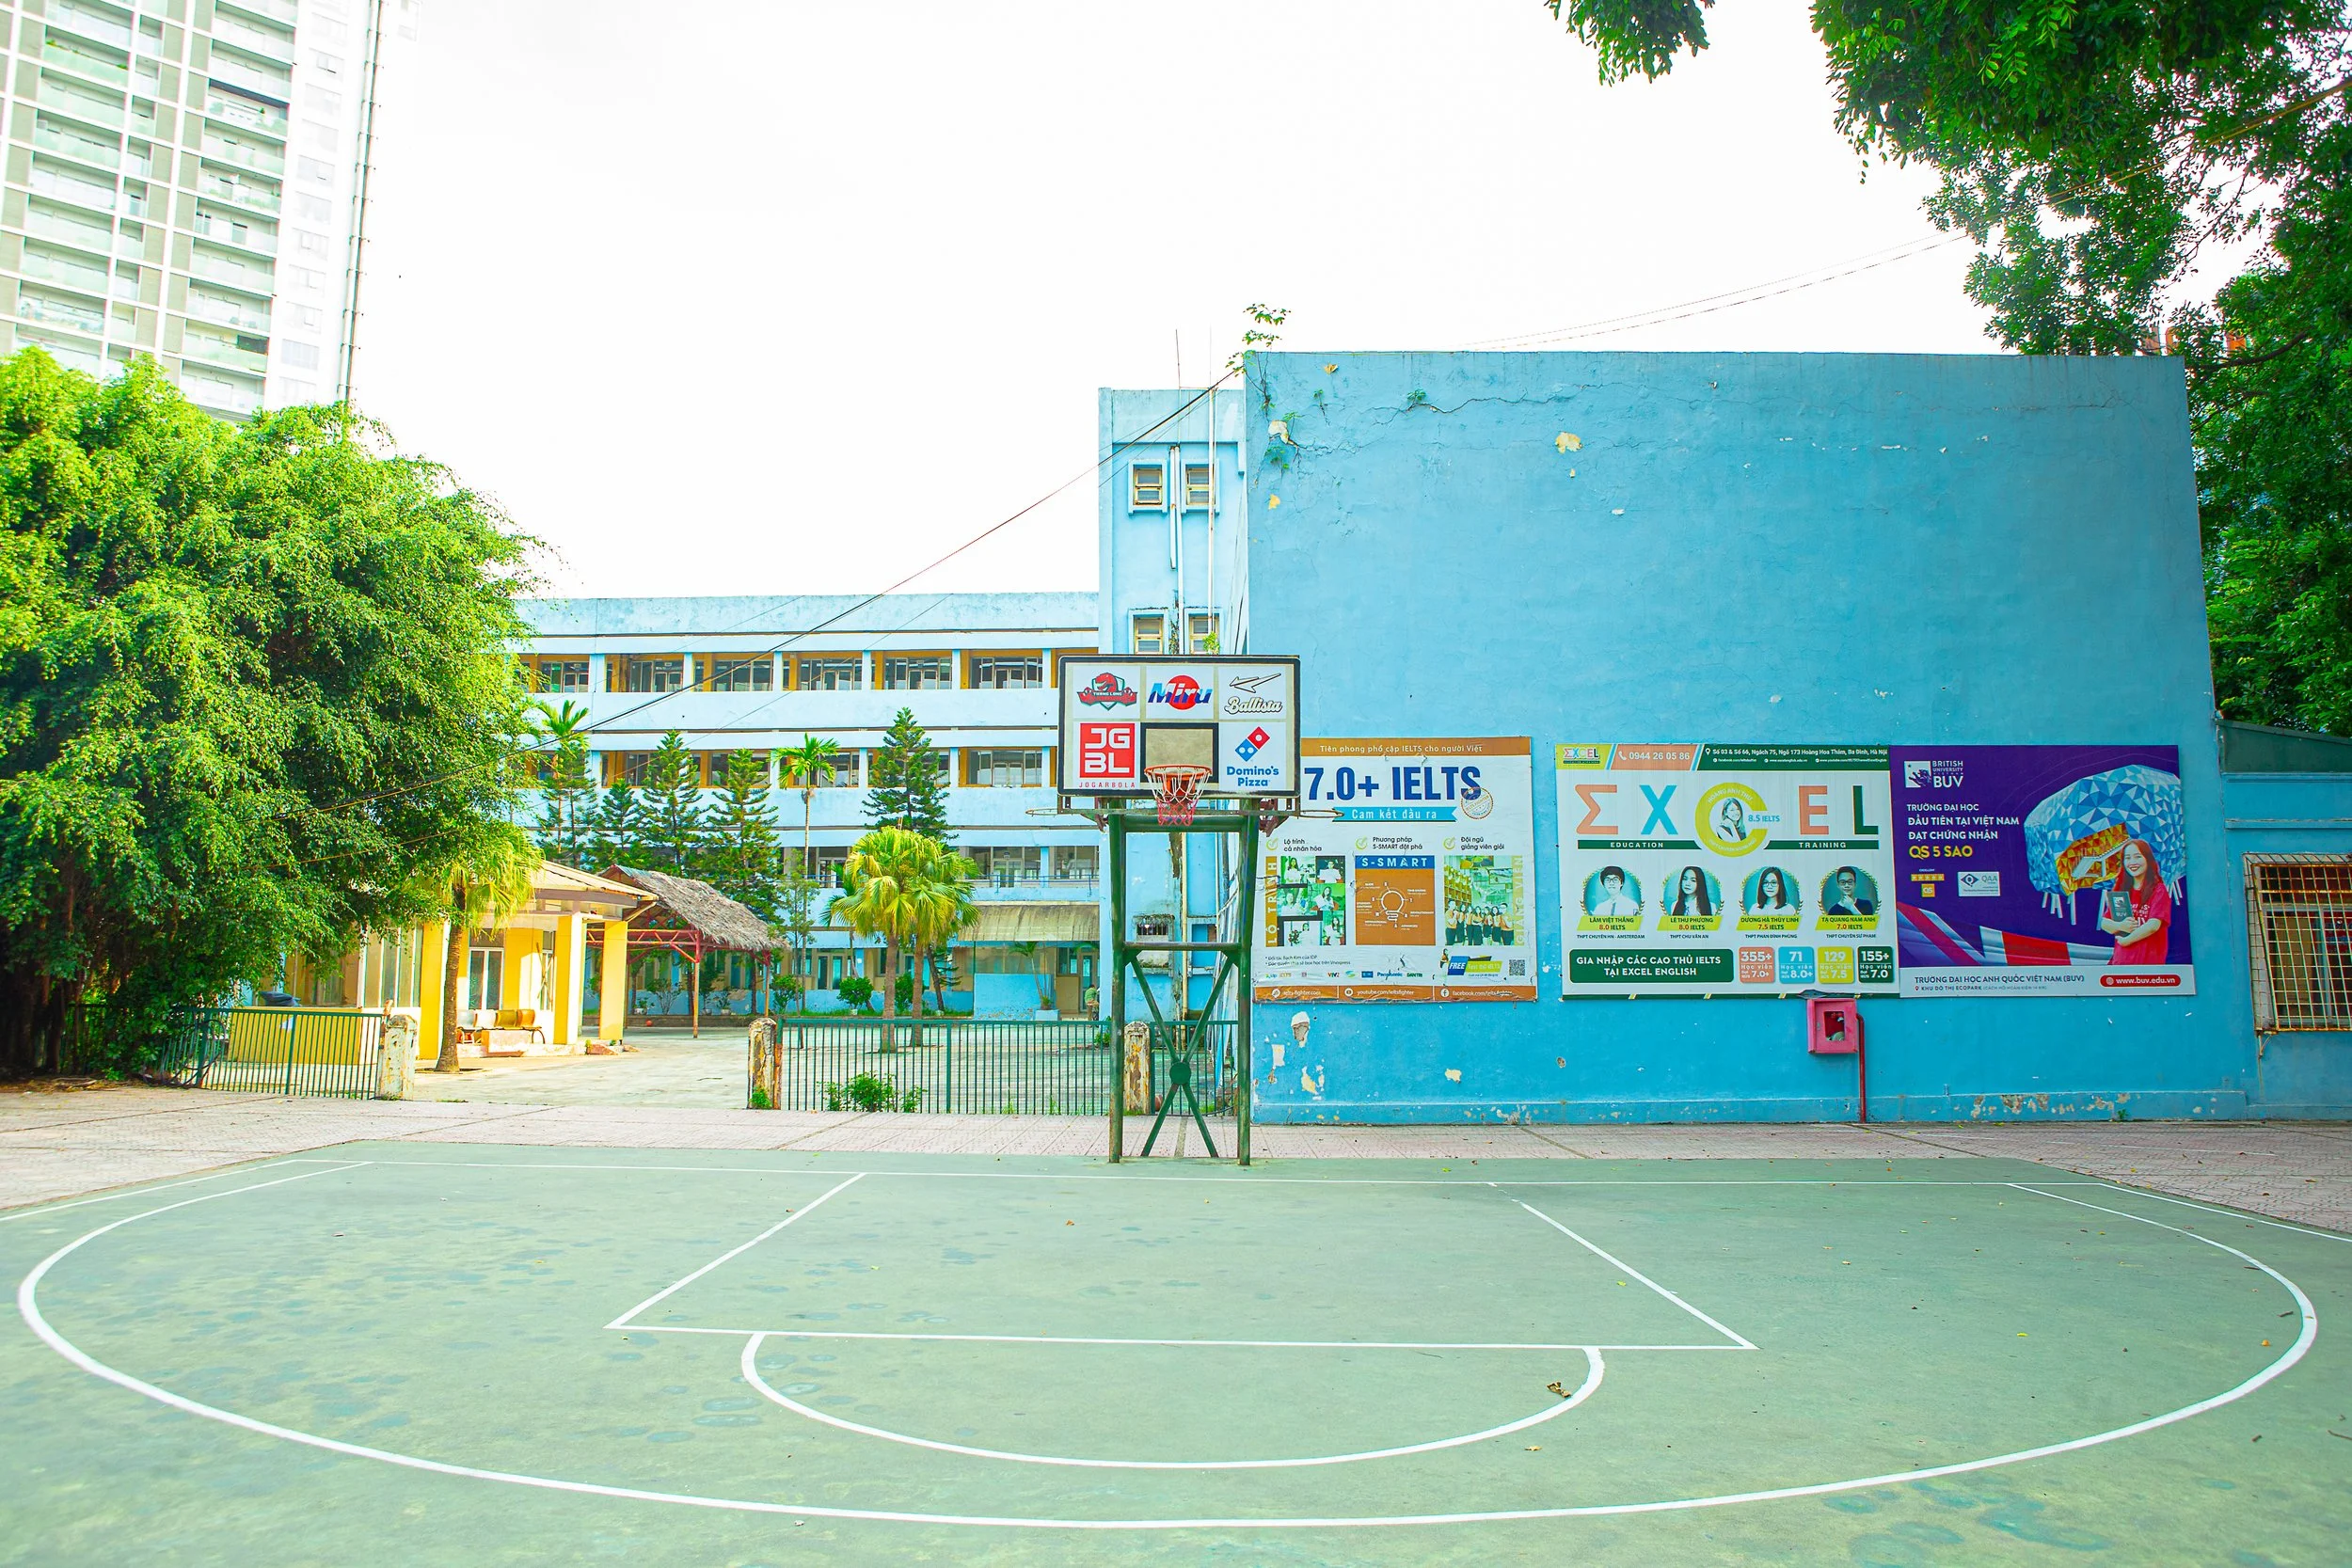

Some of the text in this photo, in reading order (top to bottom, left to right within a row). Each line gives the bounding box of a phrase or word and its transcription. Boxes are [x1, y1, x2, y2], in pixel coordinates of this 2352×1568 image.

[1148, 683, 1213, 704] Miru
[1224, 696, 1282, 715] Ballista
[1085, 728, 1130, 749] JG
[1340, 745, 1365, 753] phong
[1466, 744, 1483, 752] Việt
[1629, 752, 1690, 760] 0944 26 05 86
[1085, 752, 1130, 773] BL
[1227, 766, 1279, 776] Domino's
[1237, 778, 1268, 786] Pizza
[1304, 767, 1481, 800] 7.0+ IELTS
[1933, 775, 1963, 788] BUV
[1907, 803, 1979, 812] TRƯỜNG ĐẠI HỌC
[1352, 809, 1375, 819] Cam
[1379, 808, 1396, 819] kết
[1425, 811, 1437, 819] ra
[1908, 814, 2019, 827] ĐẦU TIÊN TẠI VIỆT NAM
[1908, 830, 1998, 841] ĐẠT CHỨNG NHẬN
[1909, 845, 1973, 860] QS 5 SAO
[1361, 858, 1427, 866] S-SMART
[1576, 957, 1594, 965] GIA
[1597, 955, 1624, 966] NHẬP
[1627, 955, 1647, 965] CÁC
[1649, 957, 1671, 965] CAO
[1695, 956, 1721, 964] IELTS
[1740, 951, 1772, 962] 355+
[1788, 951, 1803, 962] 71
[1824, 951, 1846, 961] 129
[1861, 950, 1890, 961] 155+
[1604, 968, 1619, 977] TẠI
[1790, 970, 1813, 978] 8.0+
[1831, 970, 1847, 978] 7.5
[1870, 970, 1888, 978] 7.0
[2002, 974, 2025, 983] QUỐC
[2026, 974, 2042, 983] VIỆT
[2063, 974, 2085, 983] (BUV)
